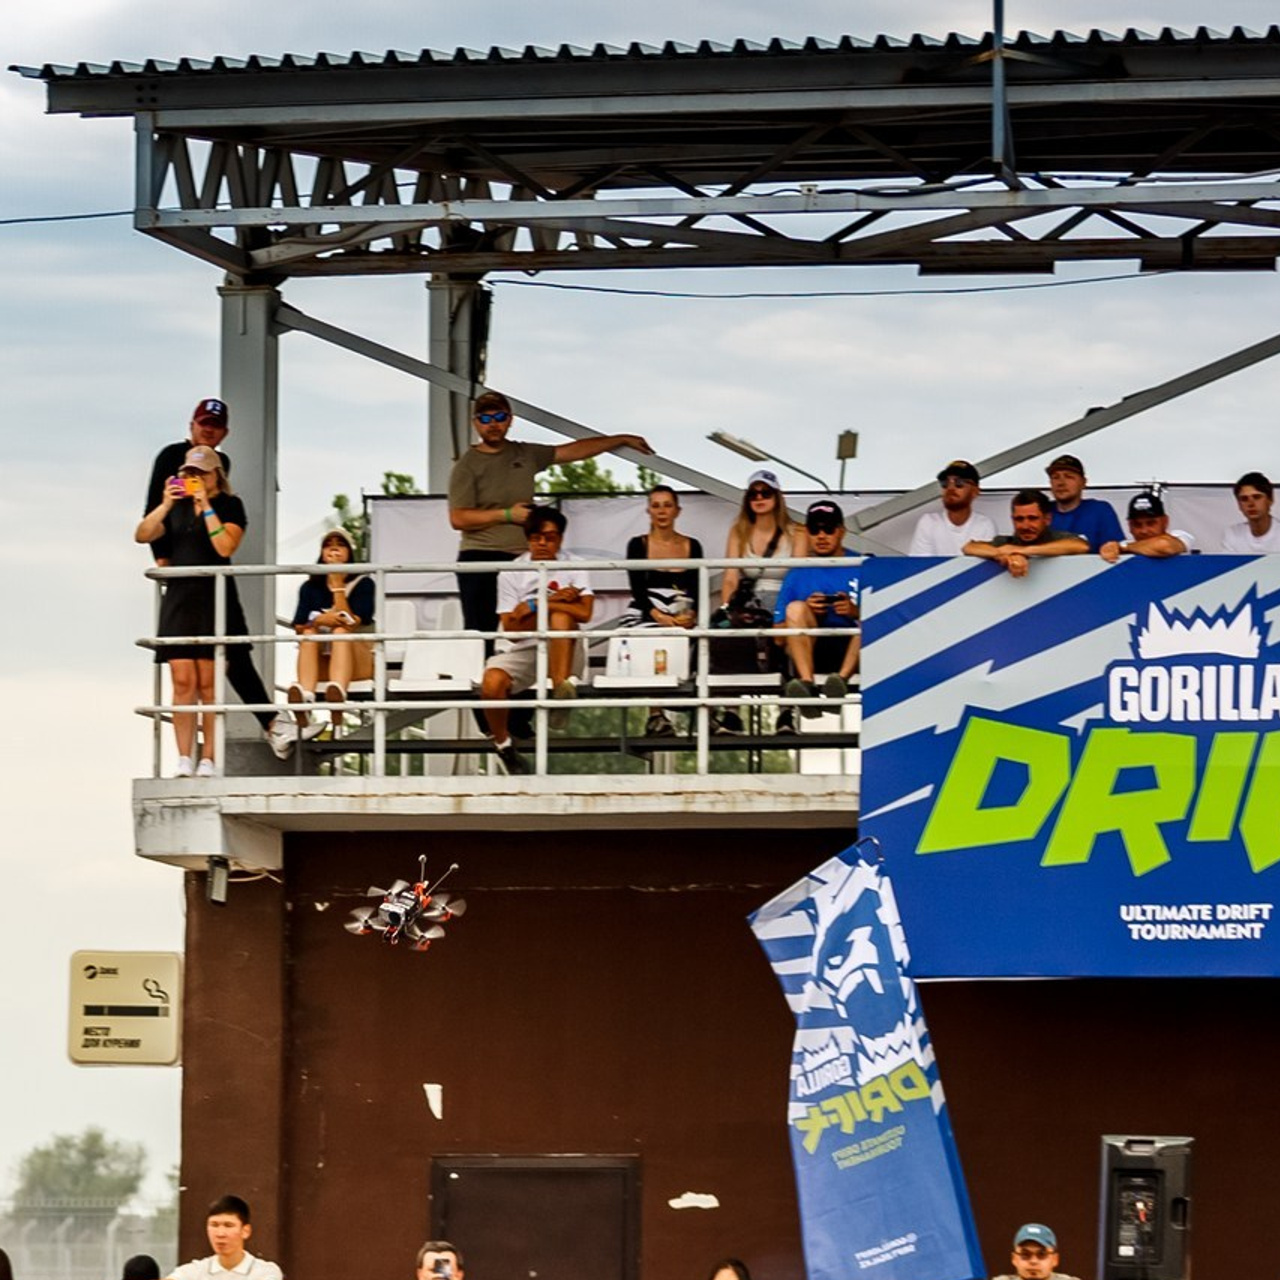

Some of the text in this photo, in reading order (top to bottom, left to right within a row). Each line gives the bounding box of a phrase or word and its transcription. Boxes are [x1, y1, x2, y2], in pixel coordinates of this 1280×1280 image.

[1120, 903, 1274, 922] ULTIMATE DRIFT
[1127, 922, 1265, 941] TOURNAMENT
